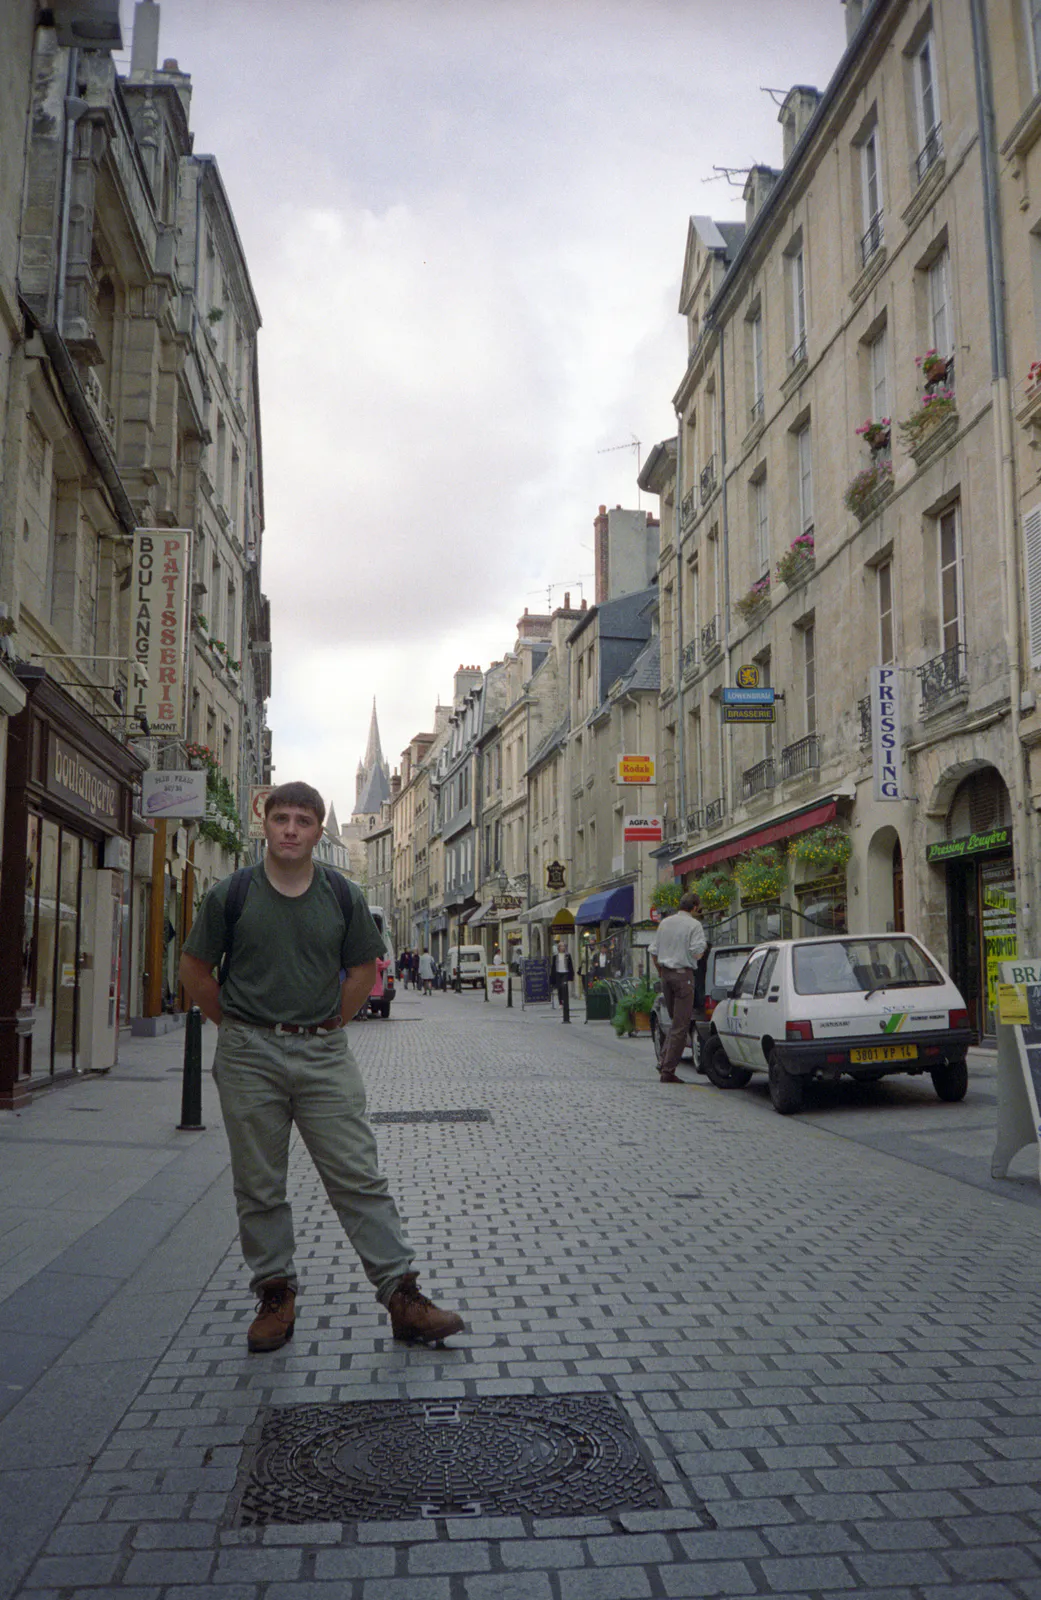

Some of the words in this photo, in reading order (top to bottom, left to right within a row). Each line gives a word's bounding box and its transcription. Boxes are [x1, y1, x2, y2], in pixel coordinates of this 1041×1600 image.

[157, 540, 180, 720] PATISSERIE
[727, 710, 771, 718] BRASSERIE
[129, 722, 178, 731] CHUMONT
[879, 669, 899, 797] PRESSING
[55, 738, 115, 816] boulangerie
[623, 764, 650, 773] Kodak
[1012, 966, 1041, 984] BR
